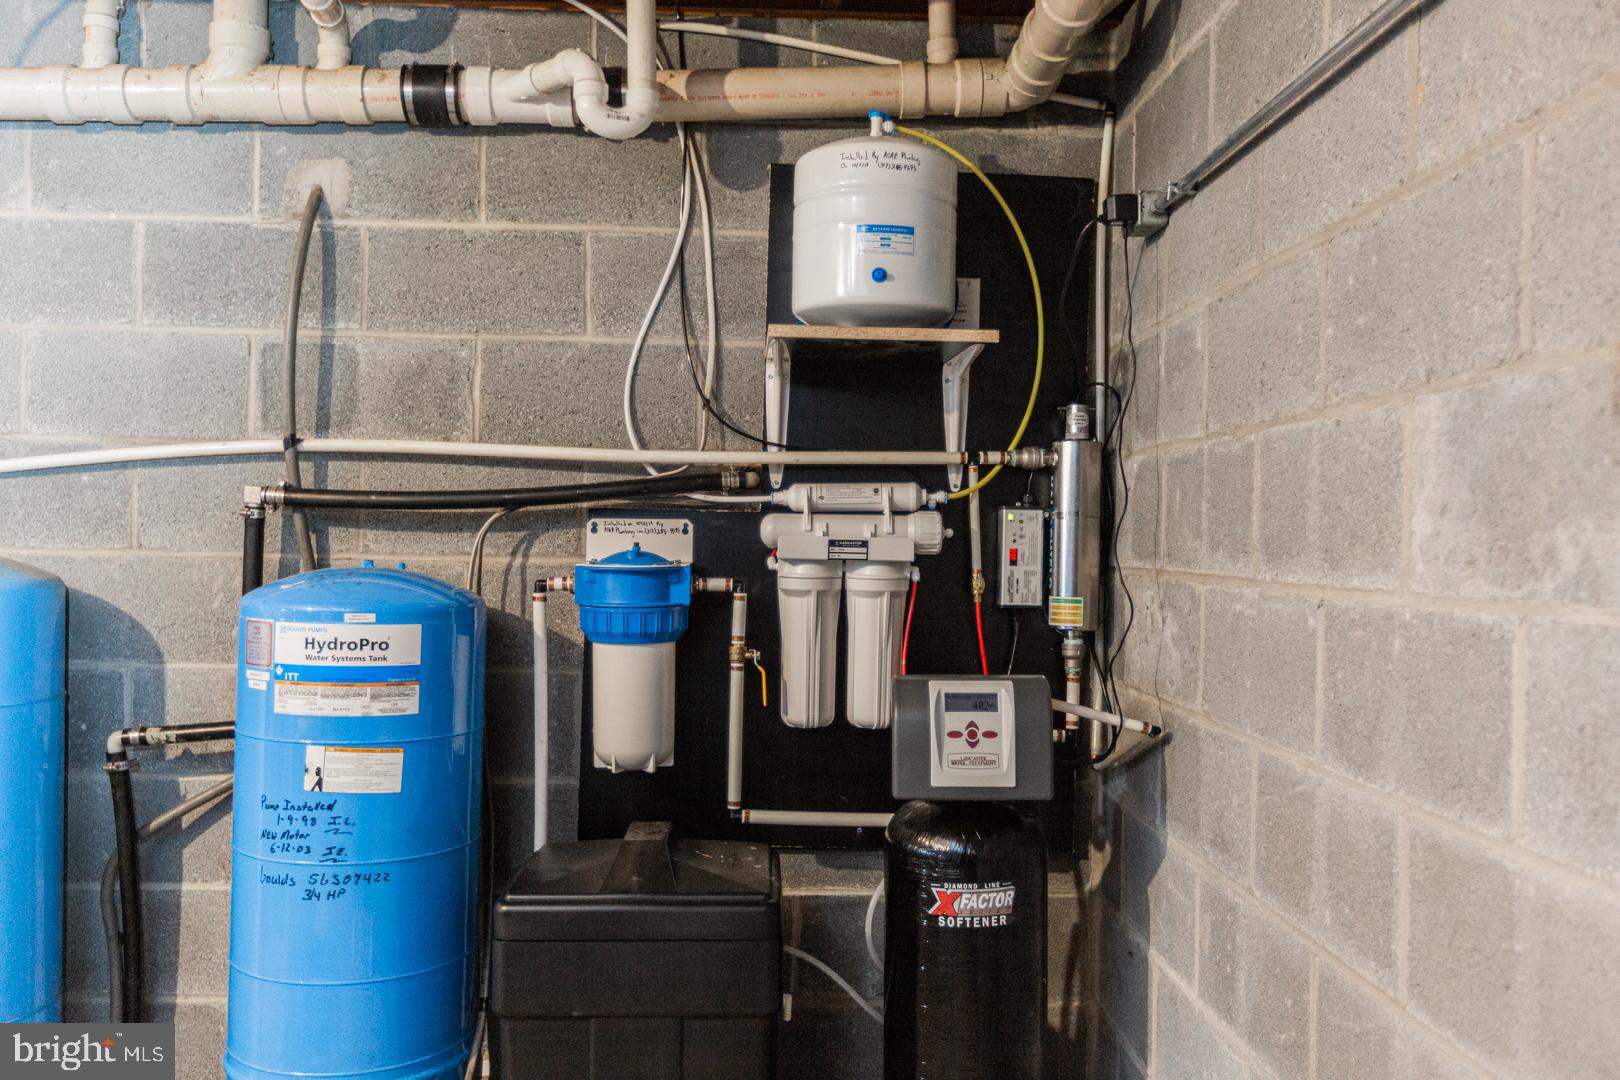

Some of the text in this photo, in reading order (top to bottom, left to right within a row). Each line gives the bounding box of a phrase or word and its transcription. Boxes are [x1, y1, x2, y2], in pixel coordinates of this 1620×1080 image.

[304, 637, 390, 653] HydroPro
[305, 654, 329, 662] Water
[331, 654, 366, 663] Systems
[284, 672, 299, 681] ITT
[283, 799, 338, 812] Installed
[280, 830, 311, 840] Motor
[943, 881, 1001, 890] DIAMOND LINE
[302, 888, 347, 901] 3/4 HP
[938, 915, 1008, 928] SOFTENER
